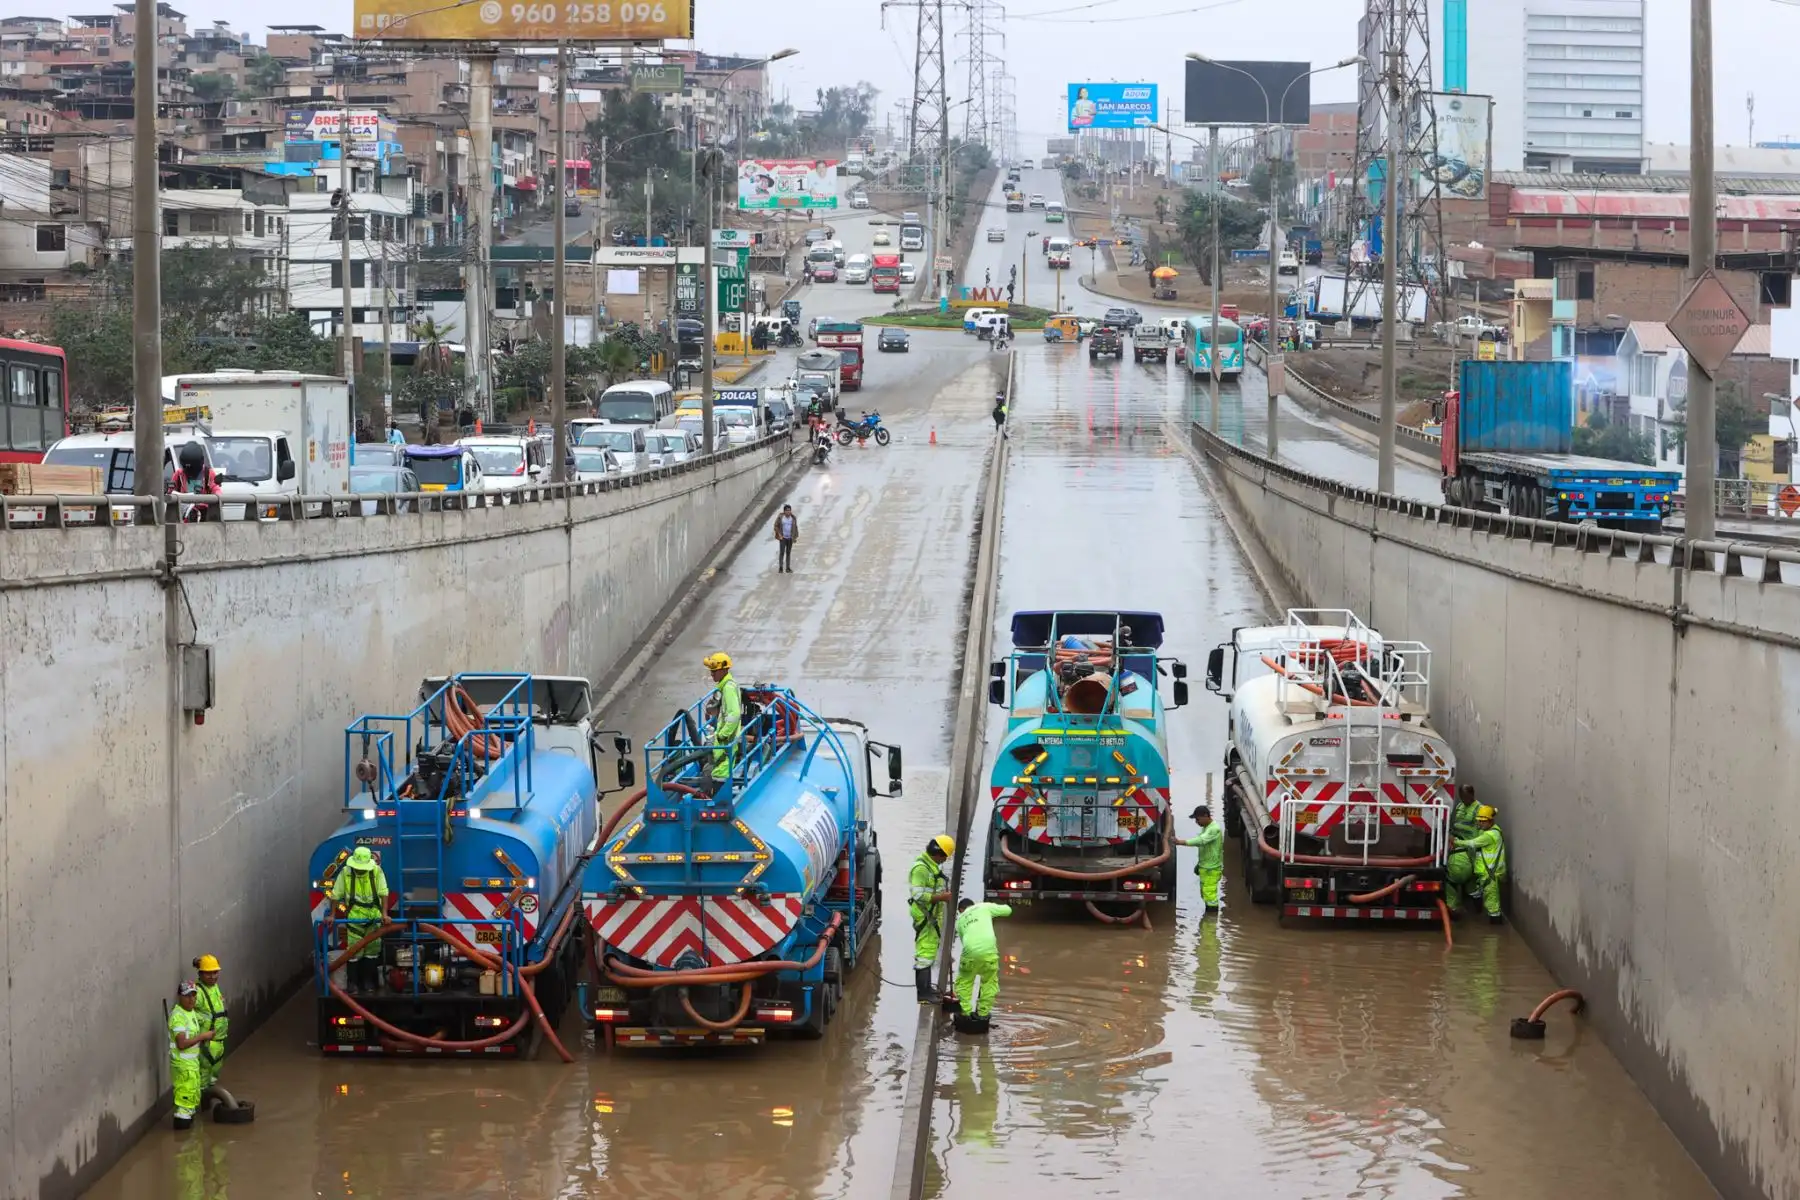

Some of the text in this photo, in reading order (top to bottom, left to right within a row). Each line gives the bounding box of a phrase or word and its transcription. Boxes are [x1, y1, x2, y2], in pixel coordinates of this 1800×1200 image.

[511, 3, 666, 23] 960 258 096
[634, 67, 665, 79] AMG
[314, 116, 378, 125] BREETES
[677, 287, 696, 299] GNV
[1687, 308, 1736, 320] DISMINUIR
[720, 391, 758, 400] SOLGAS
